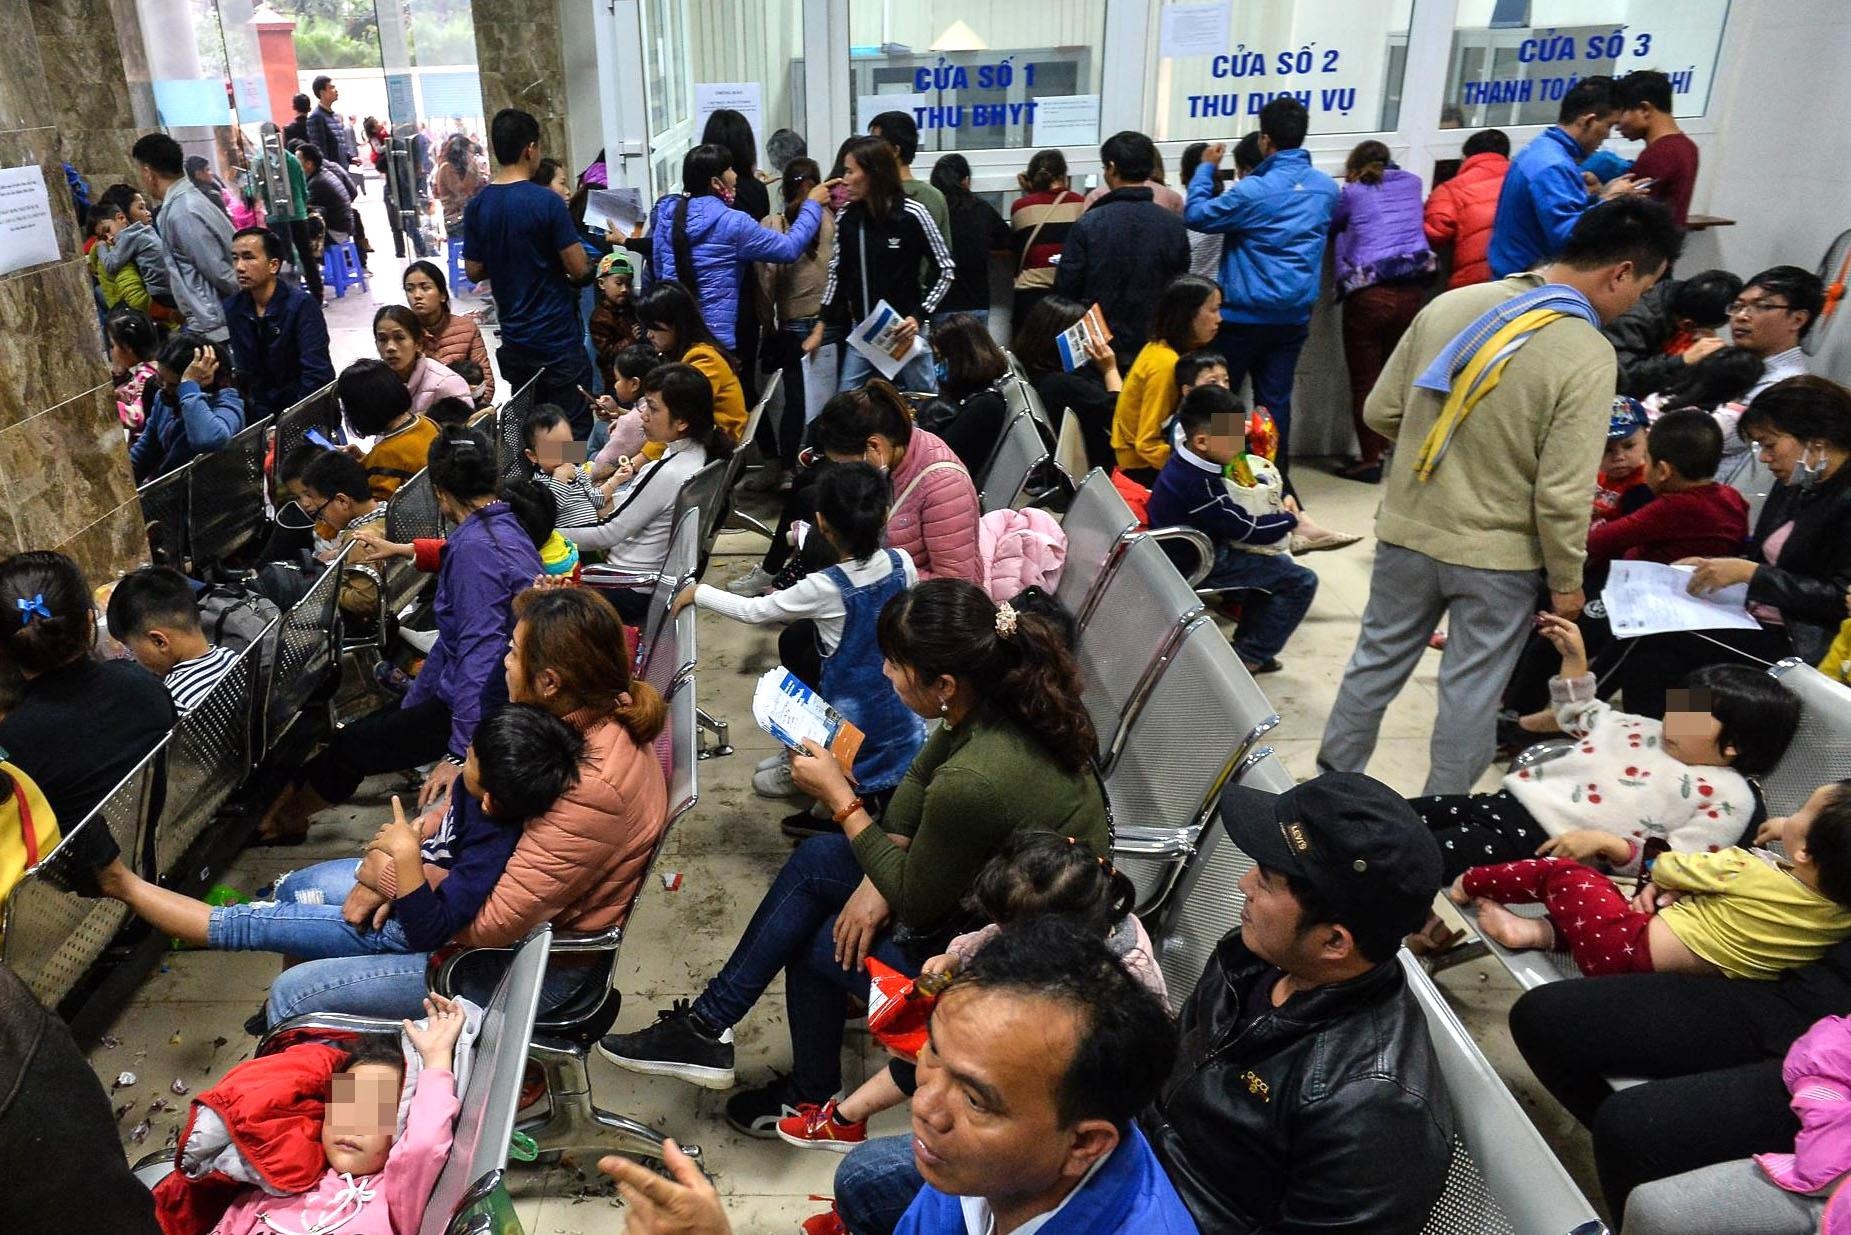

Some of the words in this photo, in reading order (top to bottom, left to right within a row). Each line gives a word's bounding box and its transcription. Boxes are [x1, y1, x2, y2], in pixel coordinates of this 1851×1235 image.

[1212, 44, 1266, 78] CỬA
[1276, 42, 1316, 75] SỐ
[1322, 50, 1339, 73] 2
[1519, 28, 1575, 62] CỬA
[1585, 26, 1629, 59] SỐ
[1634, 33, 1652, 57] 3
[915, 57, 968, 92] CỬA
[978, 56, 1014, 89] SỐ
[1024, 63, 1034, 87] 1
[1188, 94, 1238, 117] THU
[1321, 88, 1356, 116] VỤ
[1465, 79, 1533, 104] THANH
[913, 106, 963, 129] THU
[972, 102, 1038, 127] BHYT
